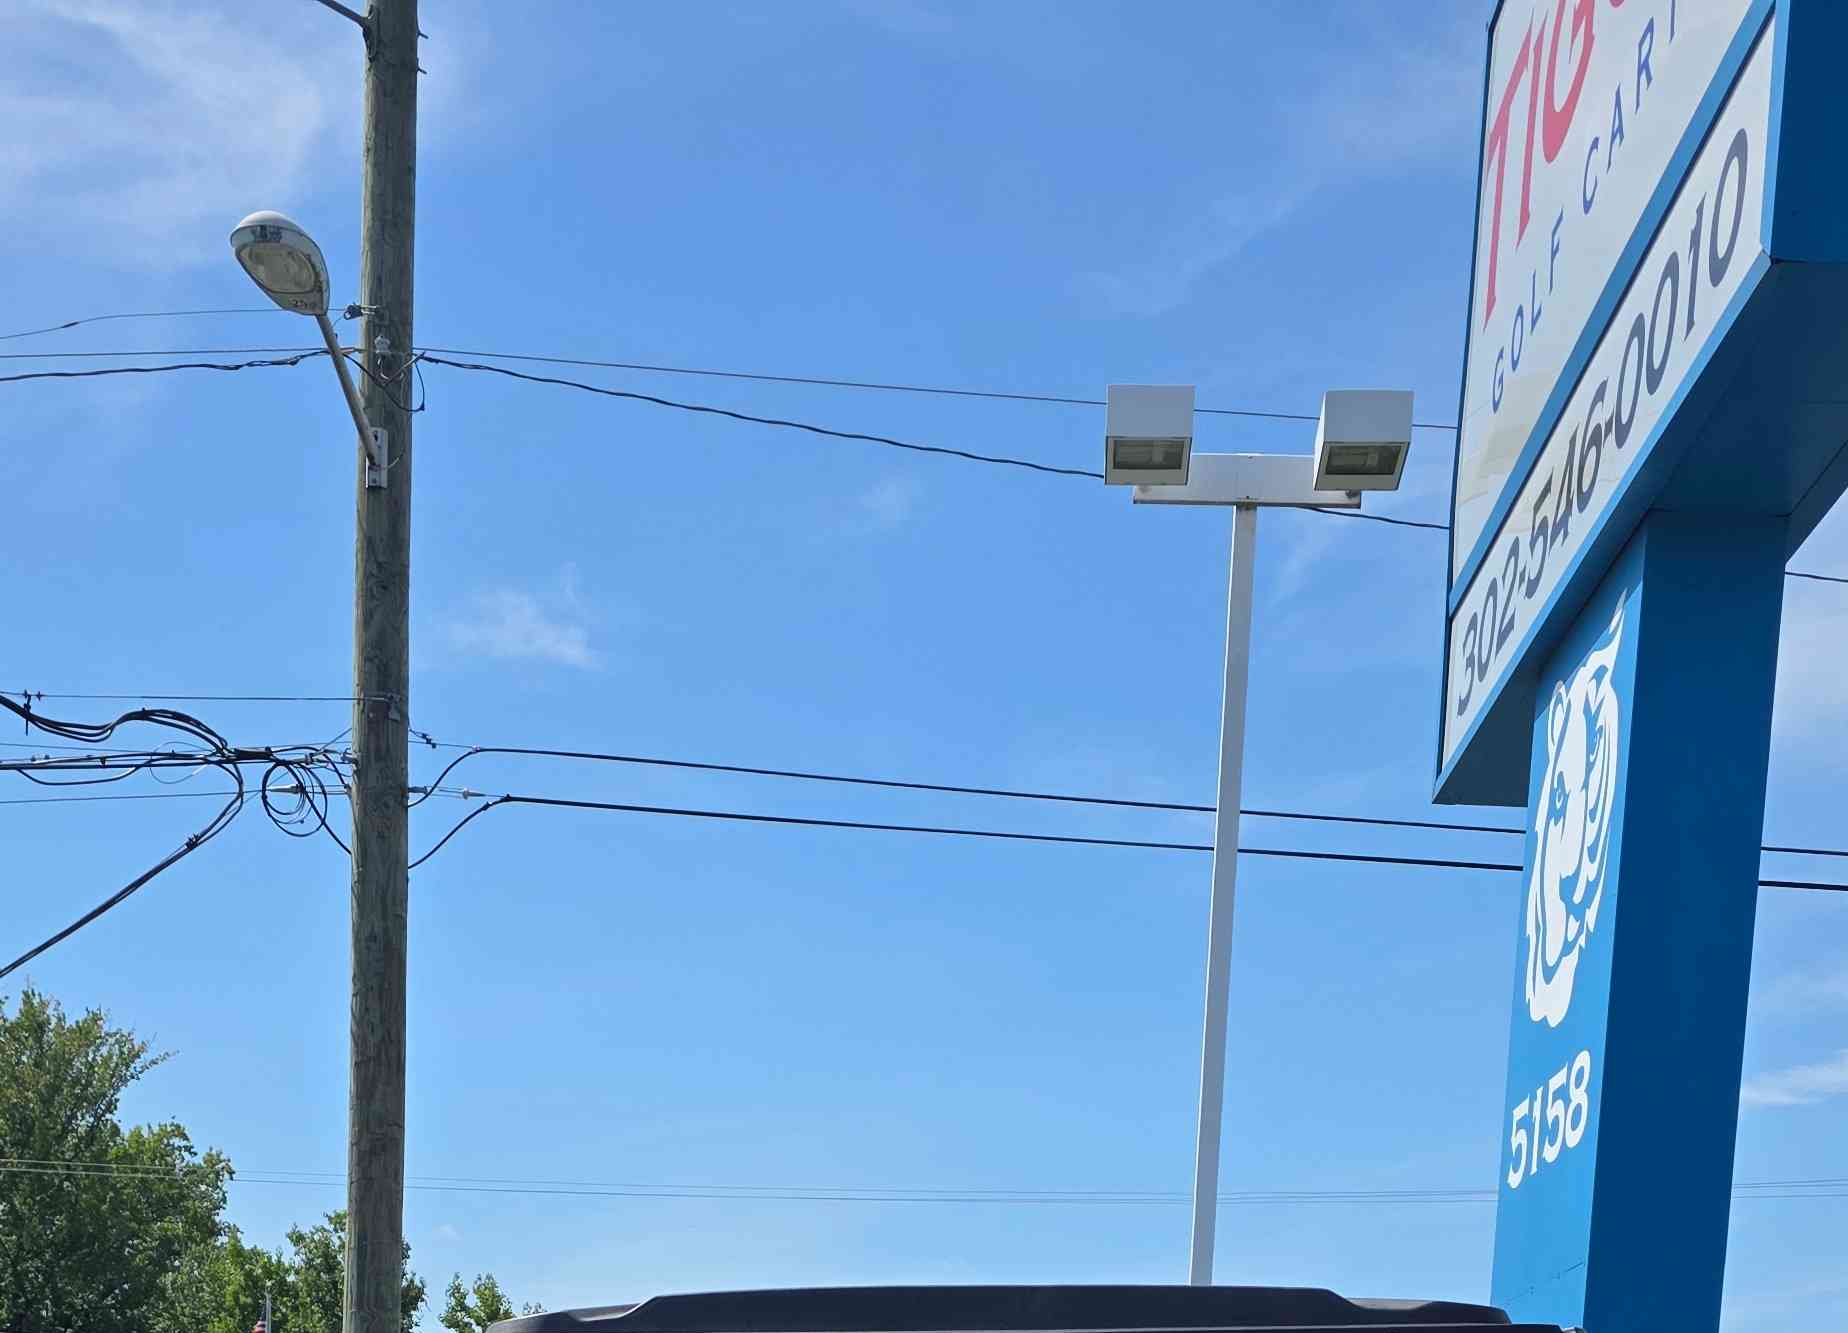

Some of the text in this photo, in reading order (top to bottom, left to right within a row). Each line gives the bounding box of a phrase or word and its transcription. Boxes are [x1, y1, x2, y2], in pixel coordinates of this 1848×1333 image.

[1484, 0, 1624, 334] TIG
[1457, 128, 1749, 717] 302-546-0010
[1492, 204, 1563, 414] GOLF
[1507, 1050, 1591, 1189] 5158
